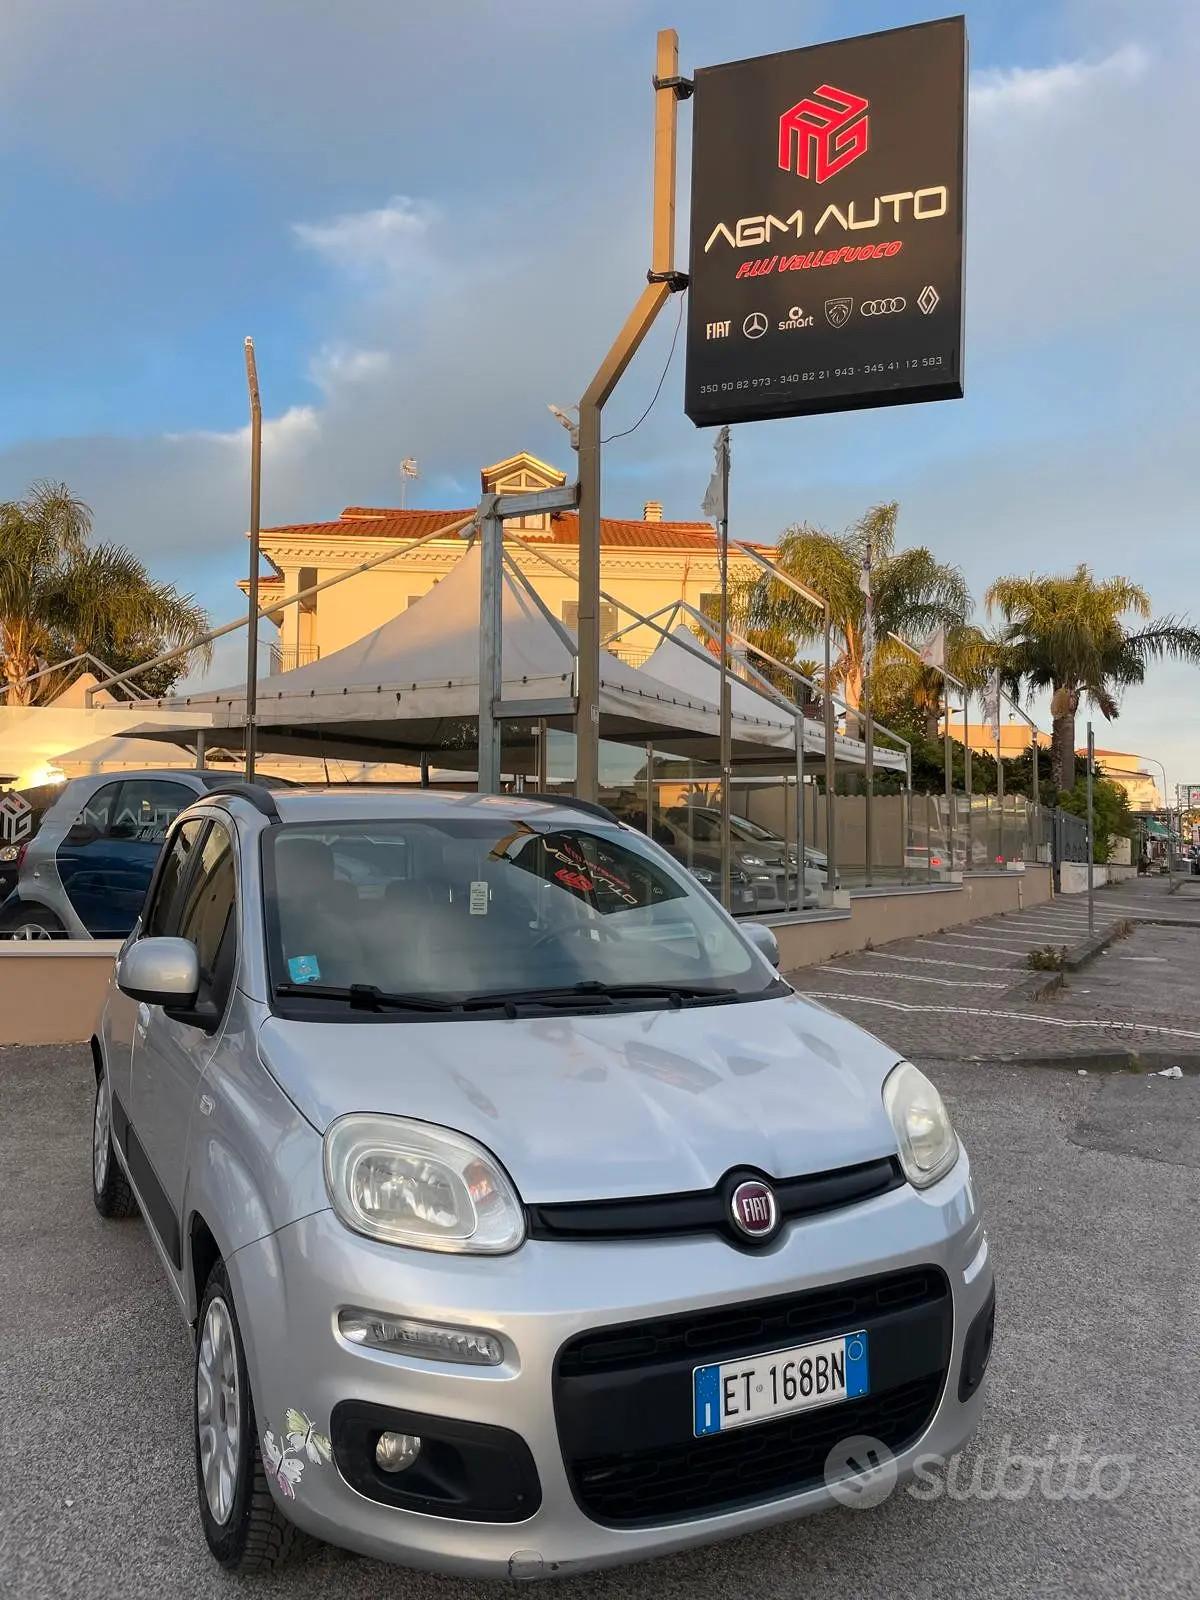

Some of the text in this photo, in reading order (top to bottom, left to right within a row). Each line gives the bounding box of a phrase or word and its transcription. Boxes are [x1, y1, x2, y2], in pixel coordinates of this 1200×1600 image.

[704, 185, 947, 253] AGM AUTO
[706, 320, 732, 340] FIAT
[778, 315, 814, 331] smart
[700, 384, 718, 394] 350
[721, 382, 734, 391] 90
[736, 380, 749, 390] 82
[752, 377, 771, 388] 973
[780, 374, 799, 384] 340
[802, 372, 815, 381] 82
[818, 370, 830, 379] 21
[834, 367, 854, 377] 943
[864, 363, 884, 374] 345
[887, 361, 899, 371] 41
[905, 359, 918, 369] 12
[922, 356, 942, 367] 583
[742, 1196, 768, 1222] FIAT
[723, 1350, 845, 1417] ET 168BN
